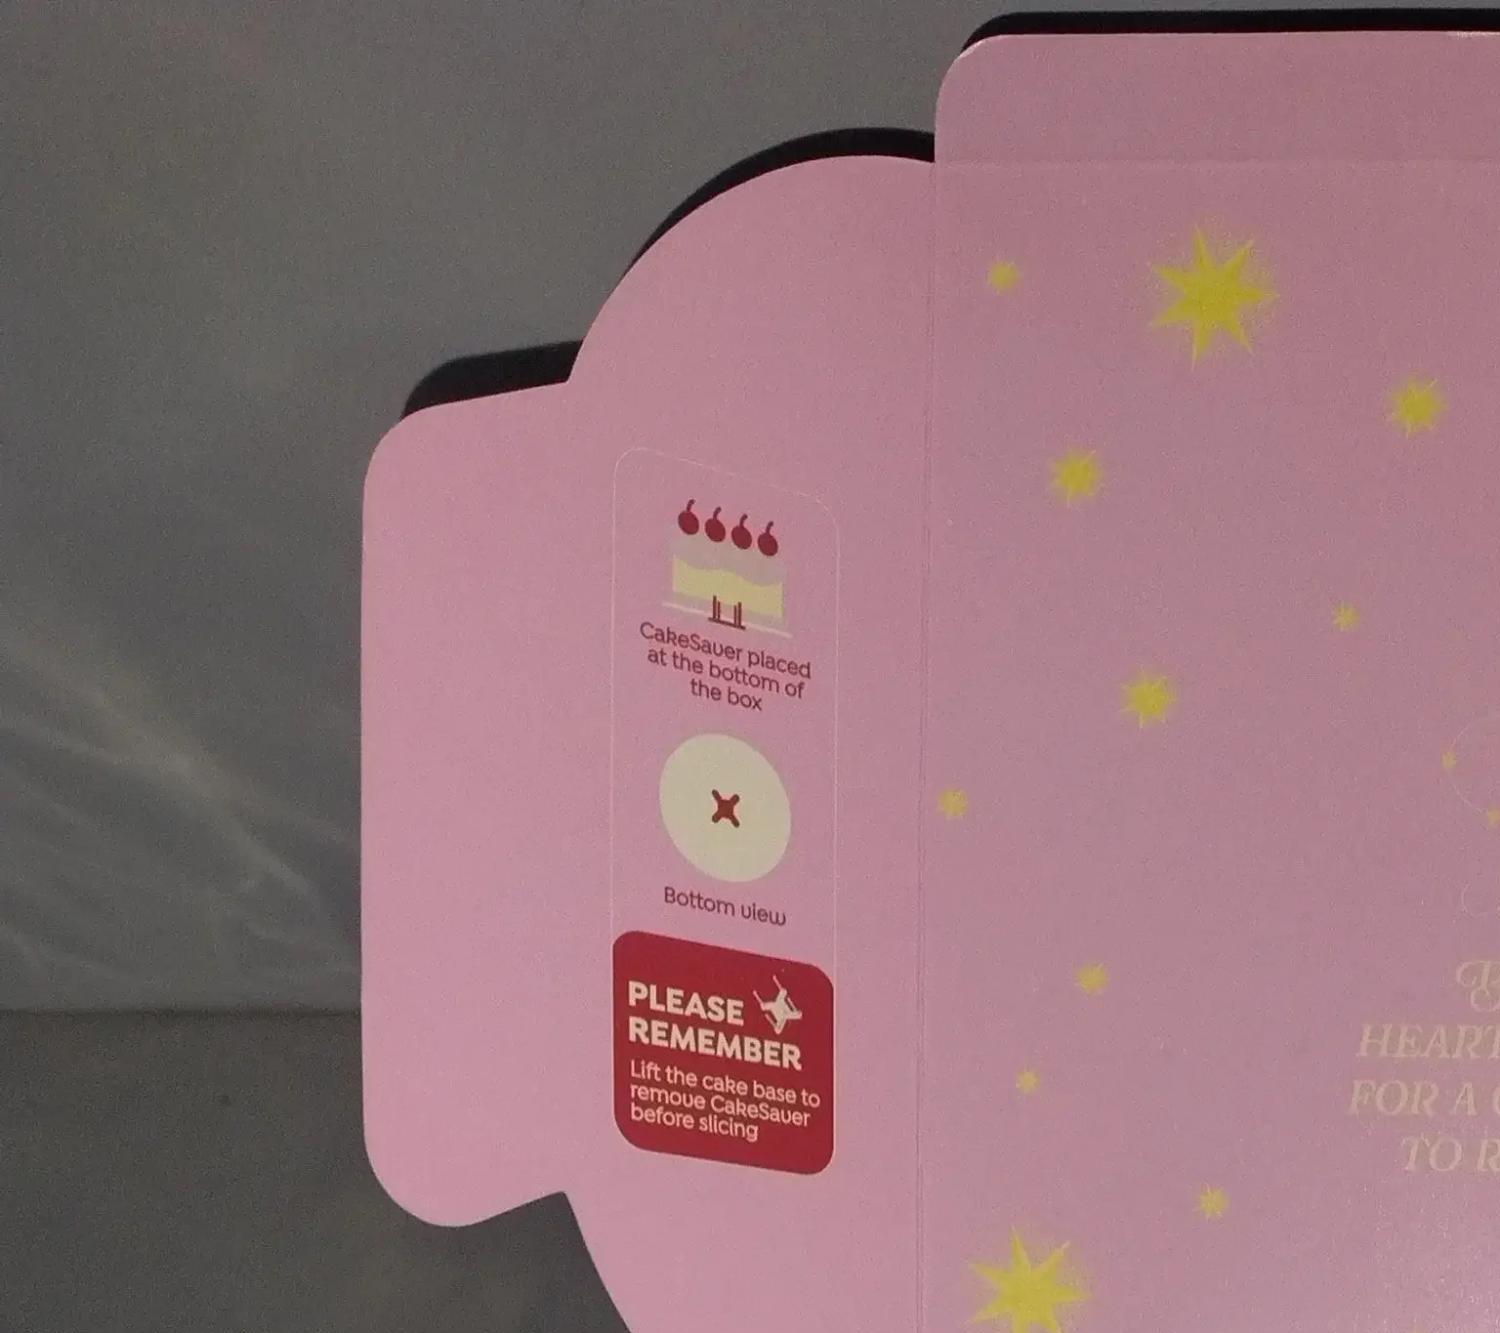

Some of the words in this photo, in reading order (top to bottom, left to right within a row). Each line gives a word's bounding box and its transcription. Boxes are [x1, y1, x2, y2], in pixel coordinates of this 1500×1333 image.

[647, 648, 667, 667] at
[672, 653, 704, 675] the
[709, 660, 780, 693] bottom
[785, 681, 805, 700] of
[748, 650, 812, 680] placed
[690, 678, 722, 701] the
[728, 686, 763, 711] box
[664, 886, 735, 917] Bottom
[628, 980, 744, 1026] PLEASE
[628, 1016, 802, 1071] REMEMBER
[630, 1060, 661, 1082] Lift
[665, 1066, 697, 1087] the
[702, 1075, 748, 1095] cake
[753, 1080, 797, 1104] base
[801, 1089, 821, 1108] to
[1348, 1079, 1440, 1117] FOR
[1449, 1081, 1478, 1117] A
[630, 1102, 695, 1129] before
[699, 1114, 759, 1143] slicing
[1401, 1135, 1463, 1173] TO
